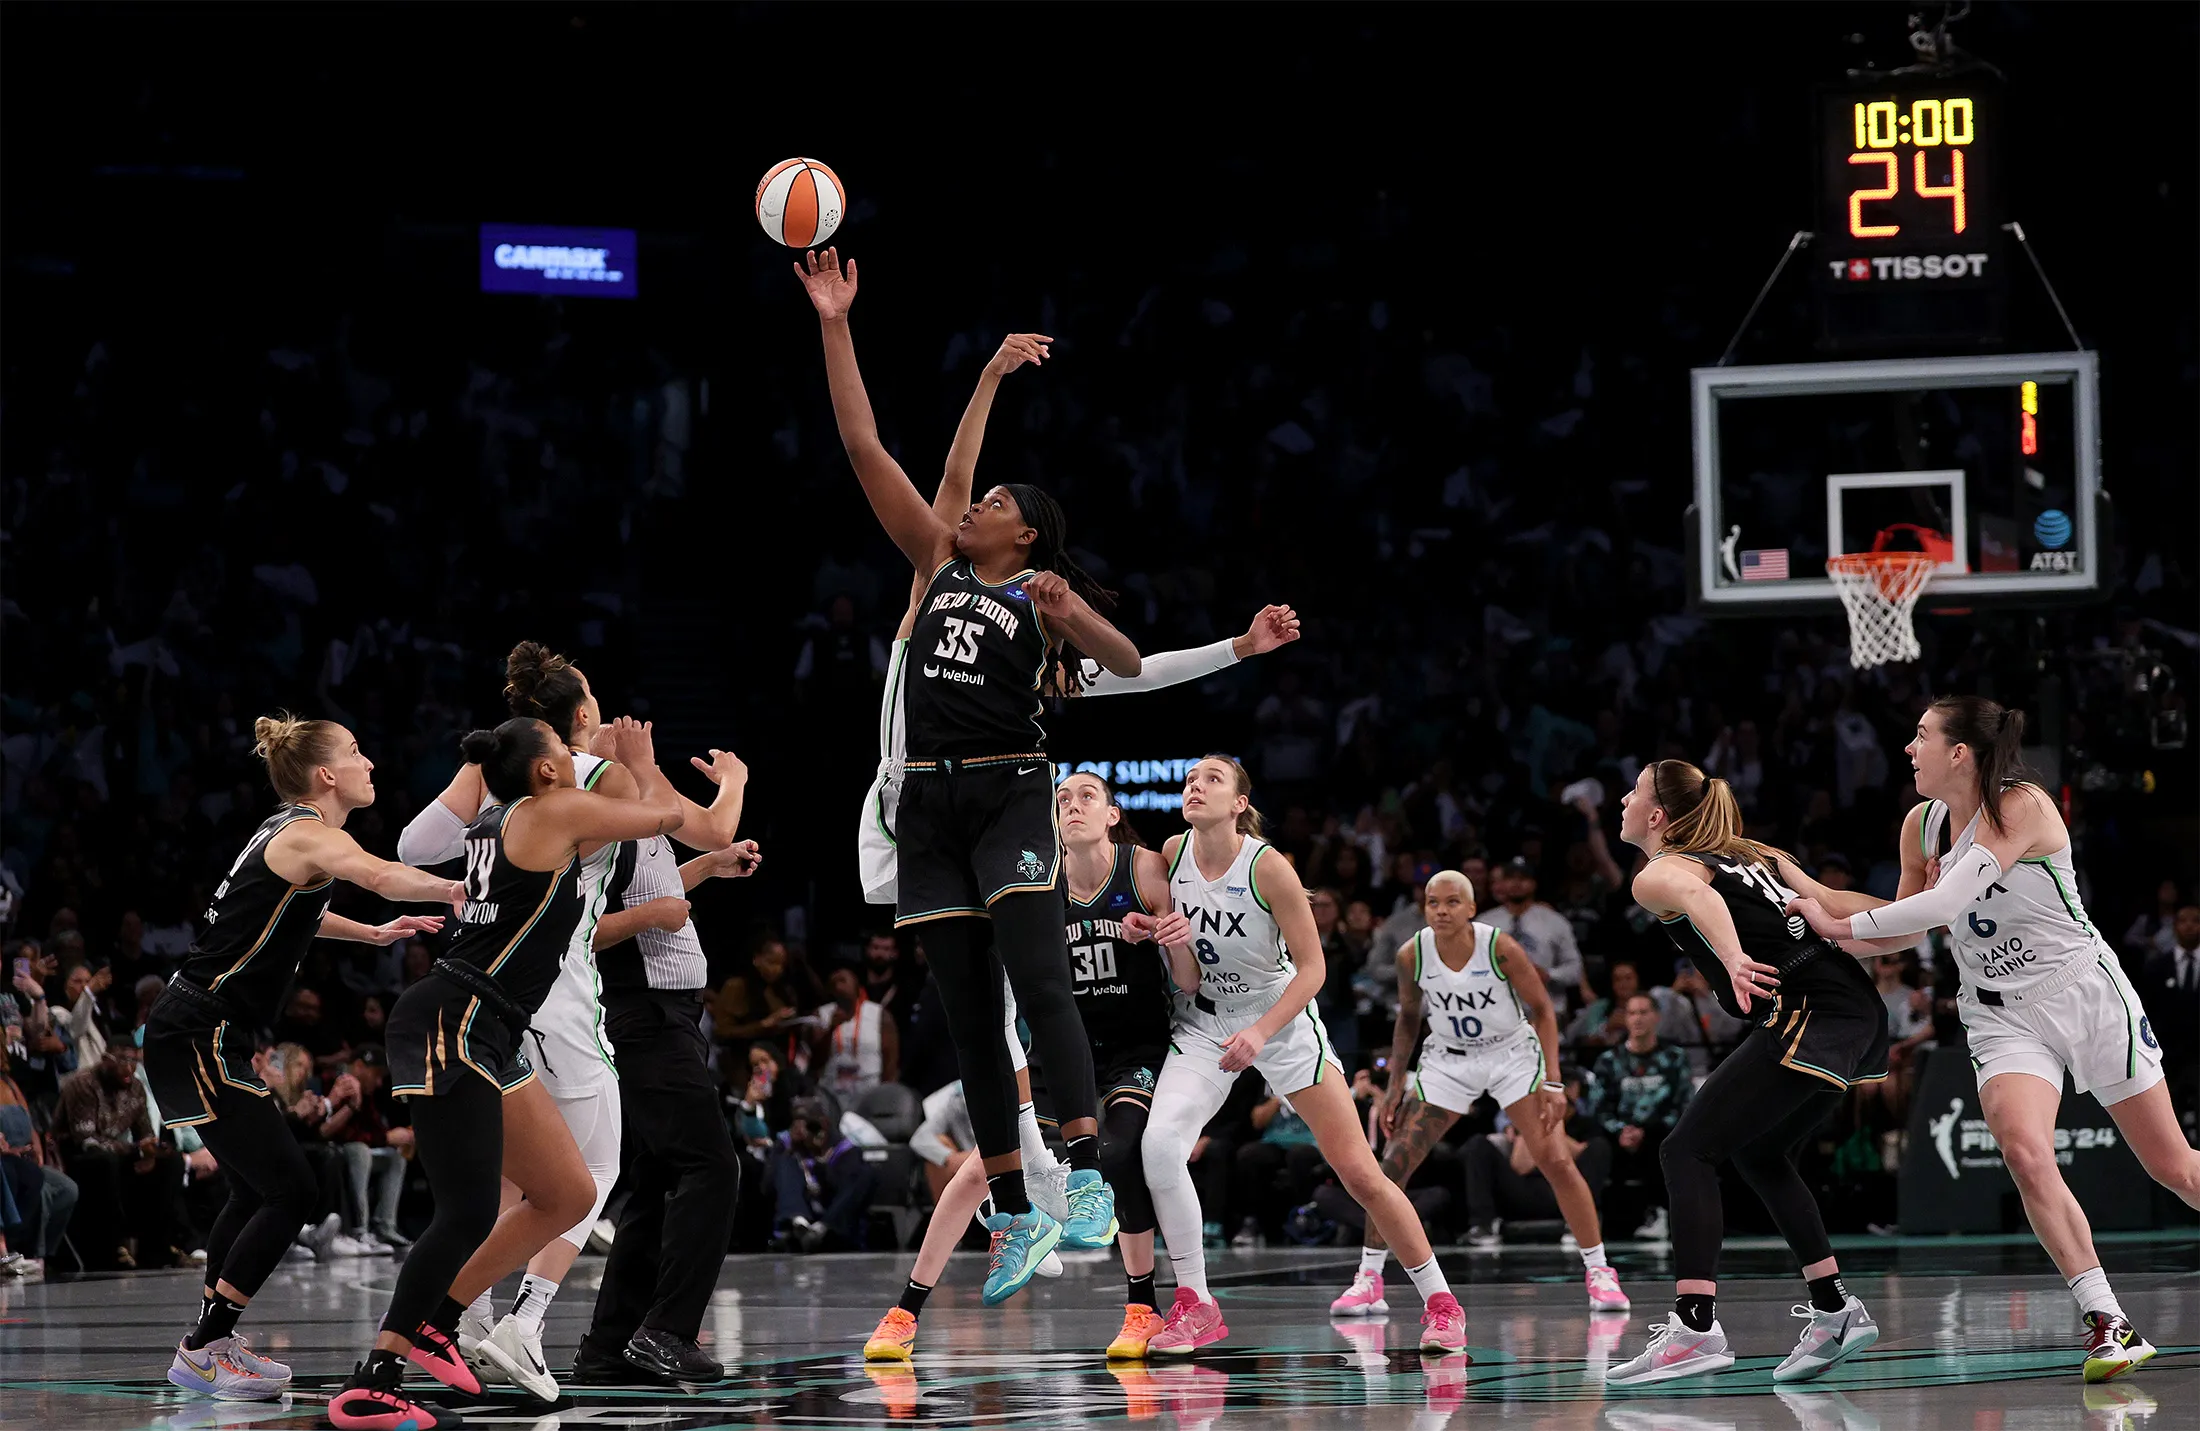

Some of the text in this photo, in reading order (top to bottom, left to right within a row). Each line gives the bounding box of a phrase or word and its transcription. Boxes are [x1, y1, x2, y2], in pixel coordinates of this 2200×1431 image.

[1854, 98, 1974, 149] 10:00
[1848, 149, 1966, 238] 24
[1872, 253, 1988, 281] TISSOT
[2030, 551, 2078, 572] AT&T
[927, 591, 1019, 641] NEW YORK
[933, 615, 985, 665] 35
[942, 667, 985, 686] Webull
[1968, 911, 1998, 939] 6
[1071, 941, 1118, 982] 30
[1195, 938, 1221, 965] 8
[1975, 937, 2023, 965] MAYO
[1983, 949, 2037, 979] CLINIC
[1092, 983, 1129, 997] Webull
[1216, 982, 1251, 996] INIC
[1447, 1015, 1483, 1039] 10
